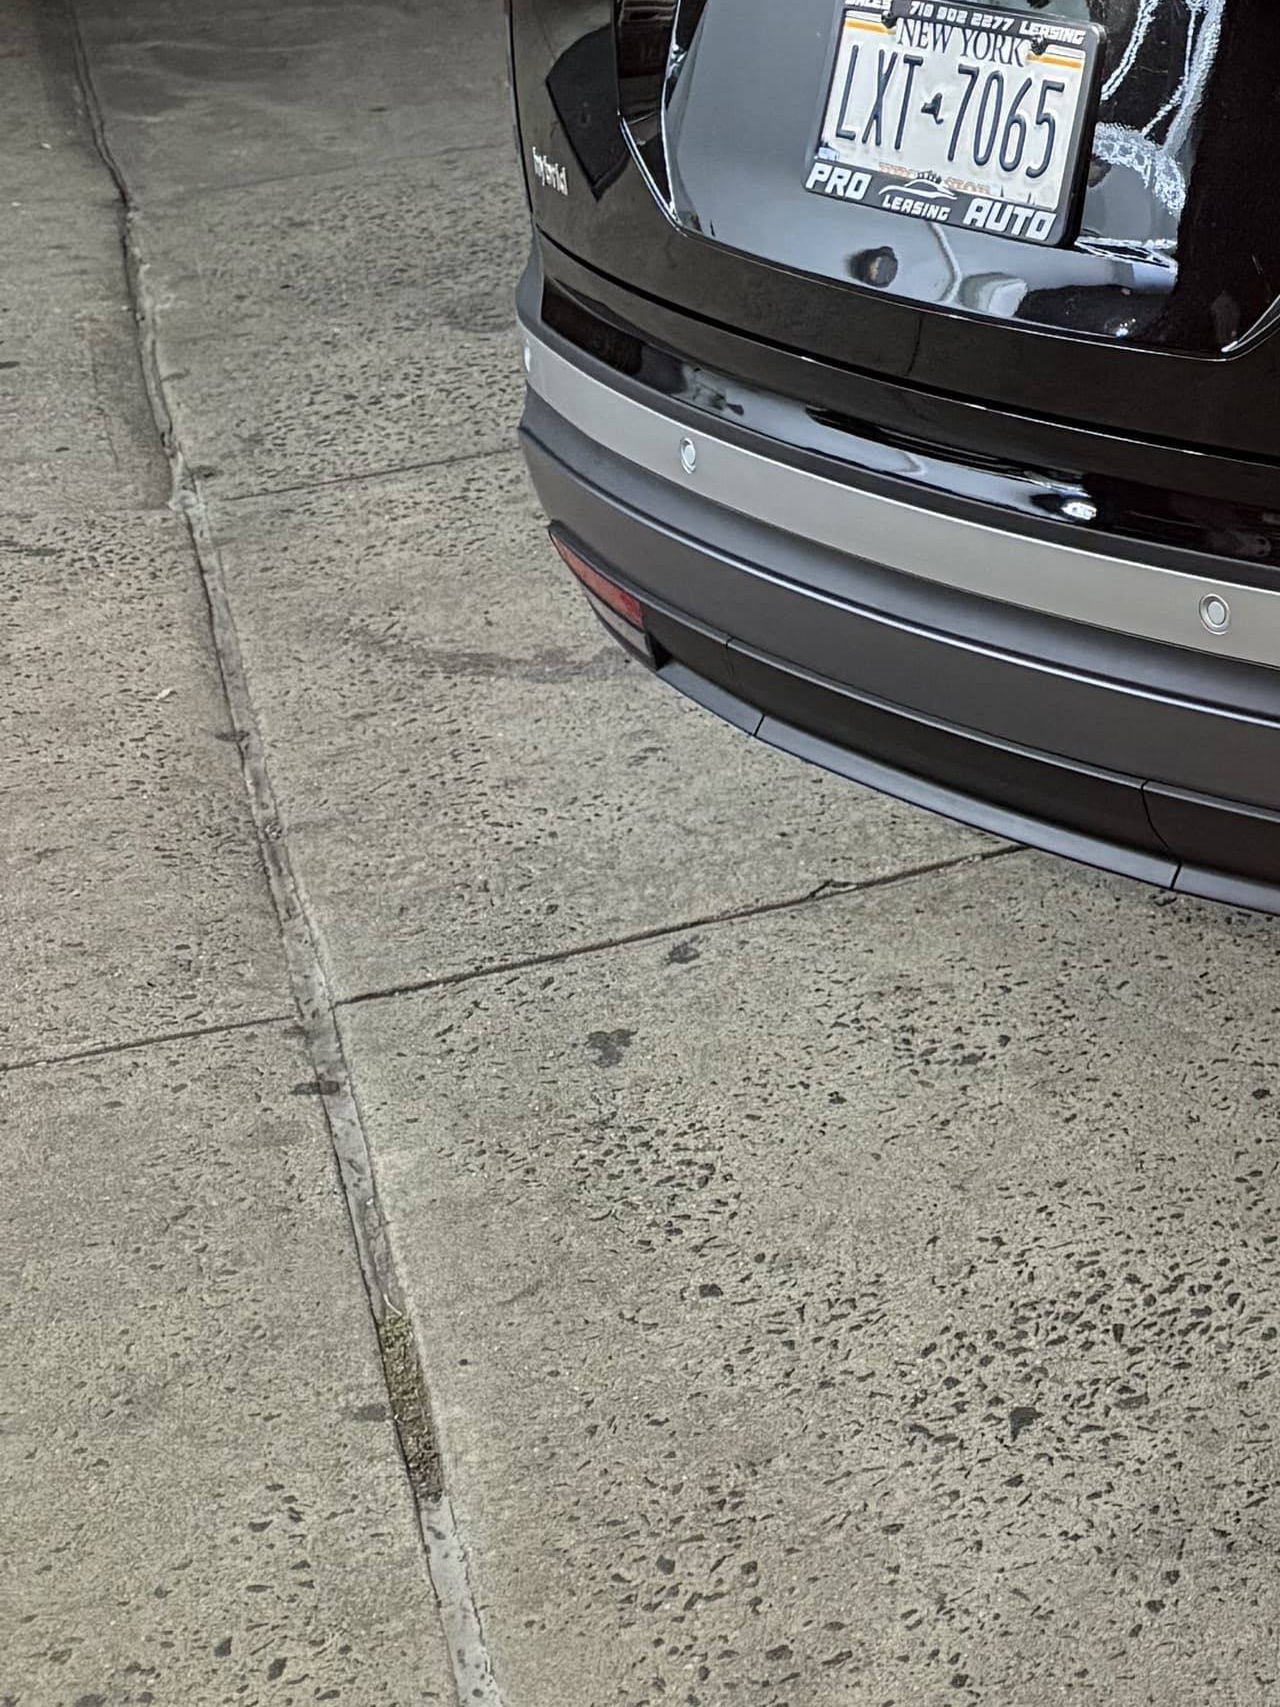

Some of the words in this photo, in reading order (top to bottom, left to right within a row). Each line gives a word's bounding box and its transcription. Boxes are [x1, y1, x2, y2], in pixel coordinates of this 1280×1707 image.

[970, 13, 1015, 31] 2277
[1019, 20, 1087, 45] LEASING
[896, 18, 953, 54] NEW
[959, 26, 1026, 68] YORK
[835, 44, 923, 150] LXT
[947, 63, 1065, 179] 7065
[805, 162, 872, 200] PRO
[963, 198, 1056, 241] AUTO
[882, 194, 951, 221] LEASING
